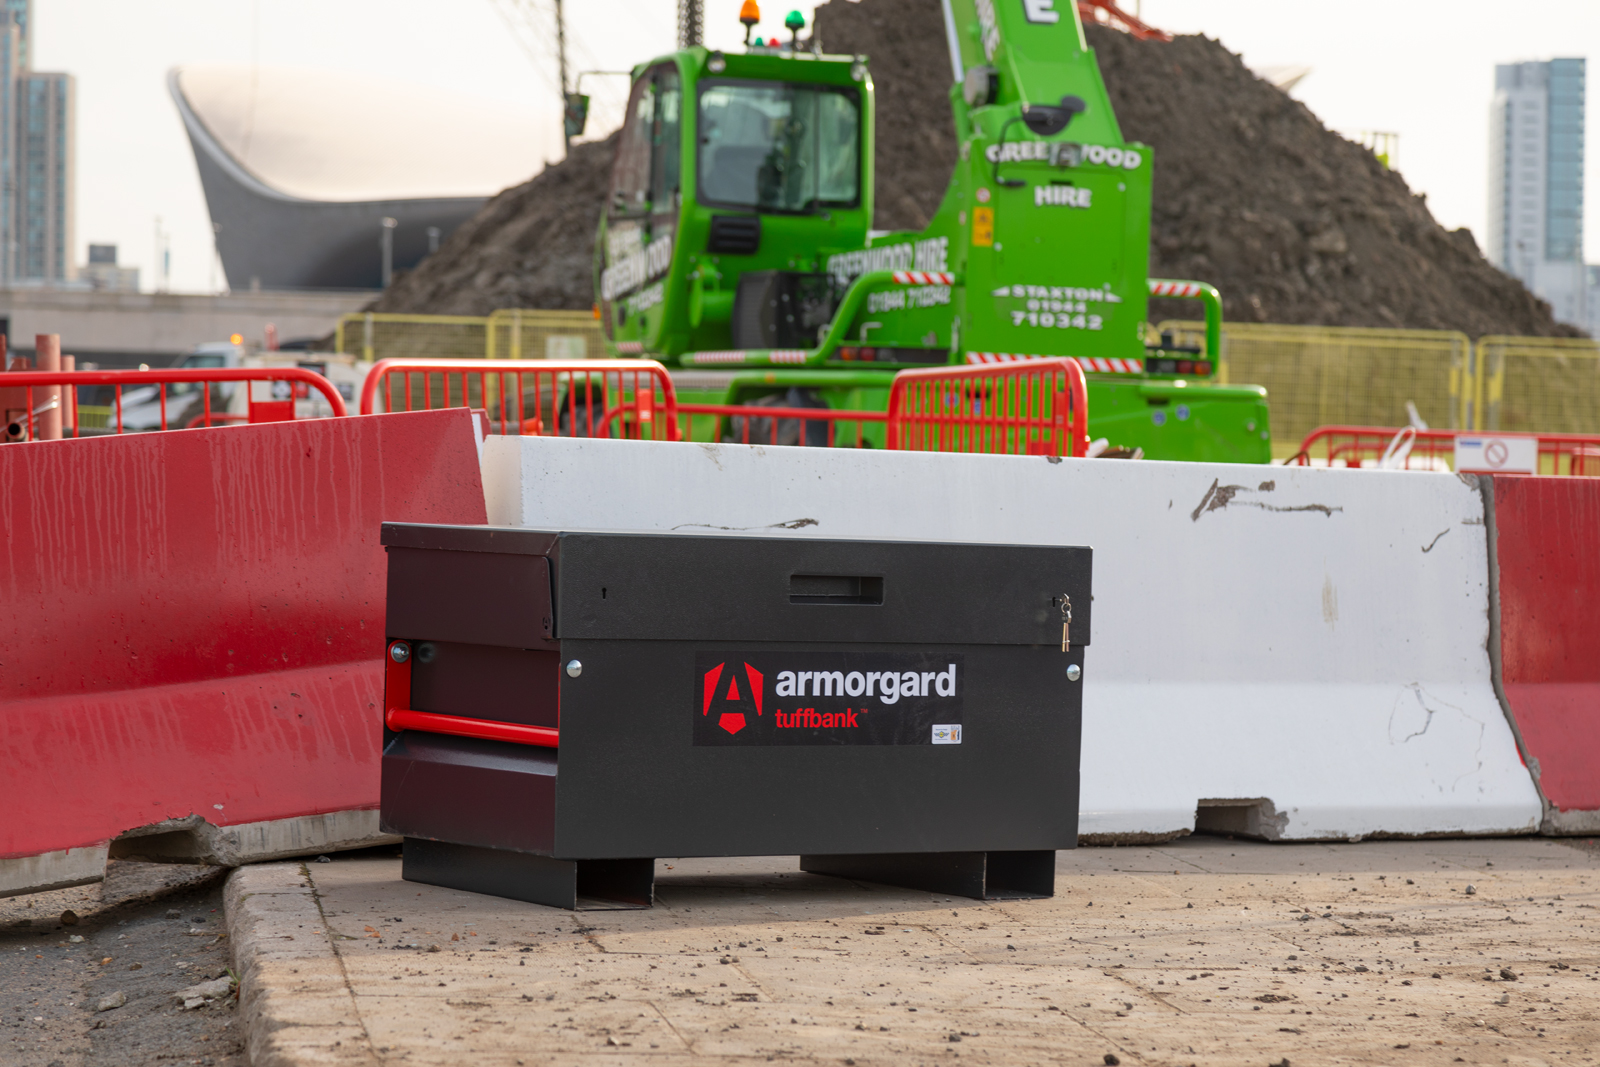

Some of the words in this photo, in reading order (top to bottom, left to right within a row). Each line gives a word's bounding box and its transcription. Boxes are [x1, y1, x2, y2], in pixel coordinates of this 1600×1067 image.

[1034, 185, 1092, 208] HIRE
[1011, 284, 1104, 302] STAXTON
[1026, 298, 1087, 313] 01944
[1010, 310, 1103, 331] 710342
[775, 663, 956, 705] armorgard
